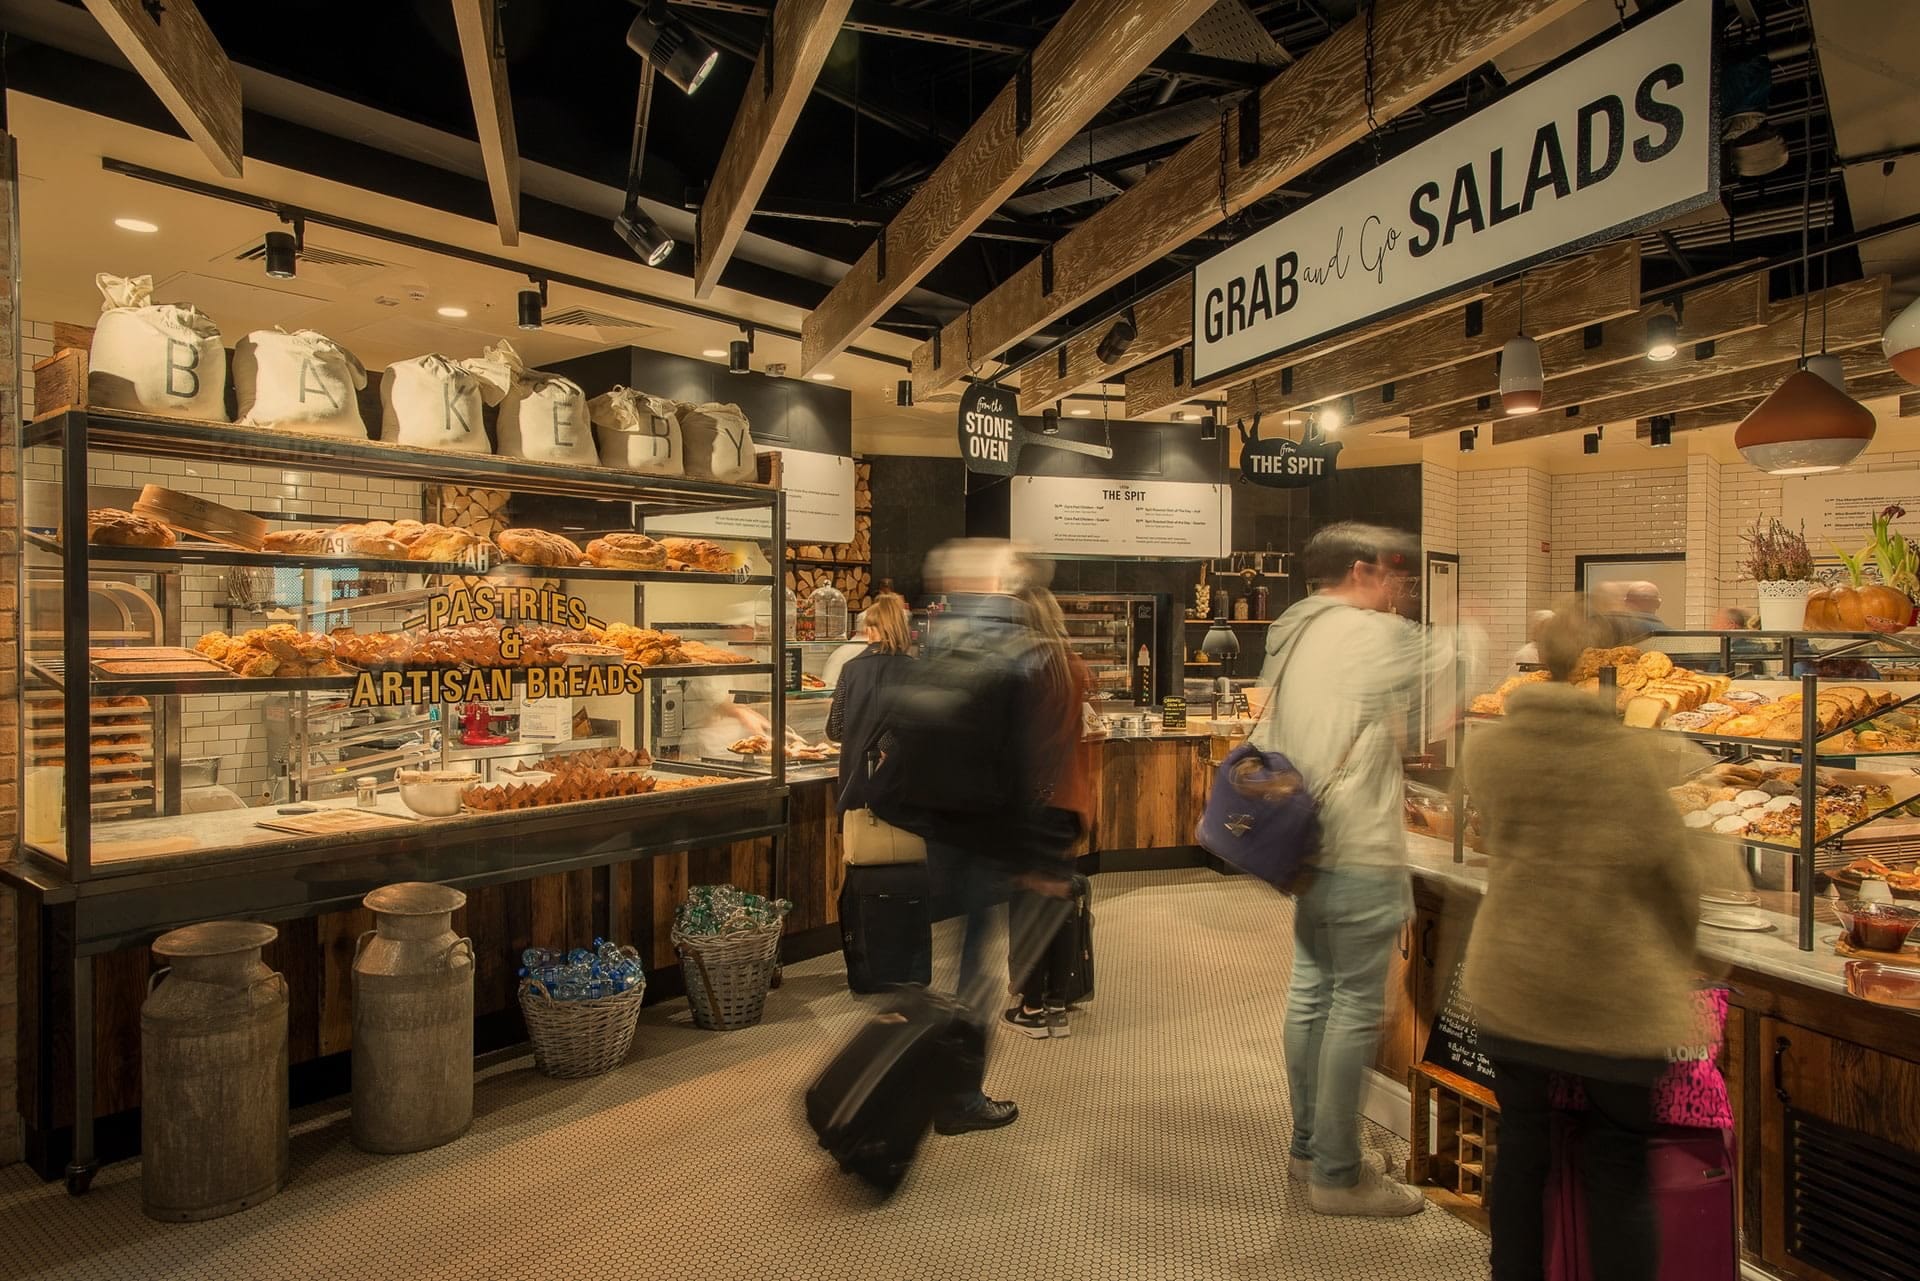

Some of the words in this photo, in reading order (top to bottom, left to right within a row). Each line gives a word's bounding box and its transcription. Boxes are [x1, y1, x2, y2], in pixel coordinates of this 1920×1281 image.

[1205, 251, 1299, 343] GRAB
[1303, 226, 1350, 285] and
[1360, 215, 1401, 284] Go
[1408, 62, 1685, 259] SALADS
[166, 338, 200, 399] B
[299, 358, 339, 409] A
[443, 383, 471, 433] K
[553, 401, 574, 447] E
[725, 428, 745, 467] Y
[965, 411, 1013, 441] STONE
[970, 436, 1009, 462] OVEN
[1250, 455, 1282, 473] THE
[1287, 457, 1324, 475] SPIT
[1102, 490, 1121, 501] THE
[1124, 490, 1146, 502] SPIT
[428, 585, 587, 632] PASTRIES
[499, 626, 523, 660] &
[351, 665, 513, 707] ARTISAN
[527, 663, 644, 699] BREADS
